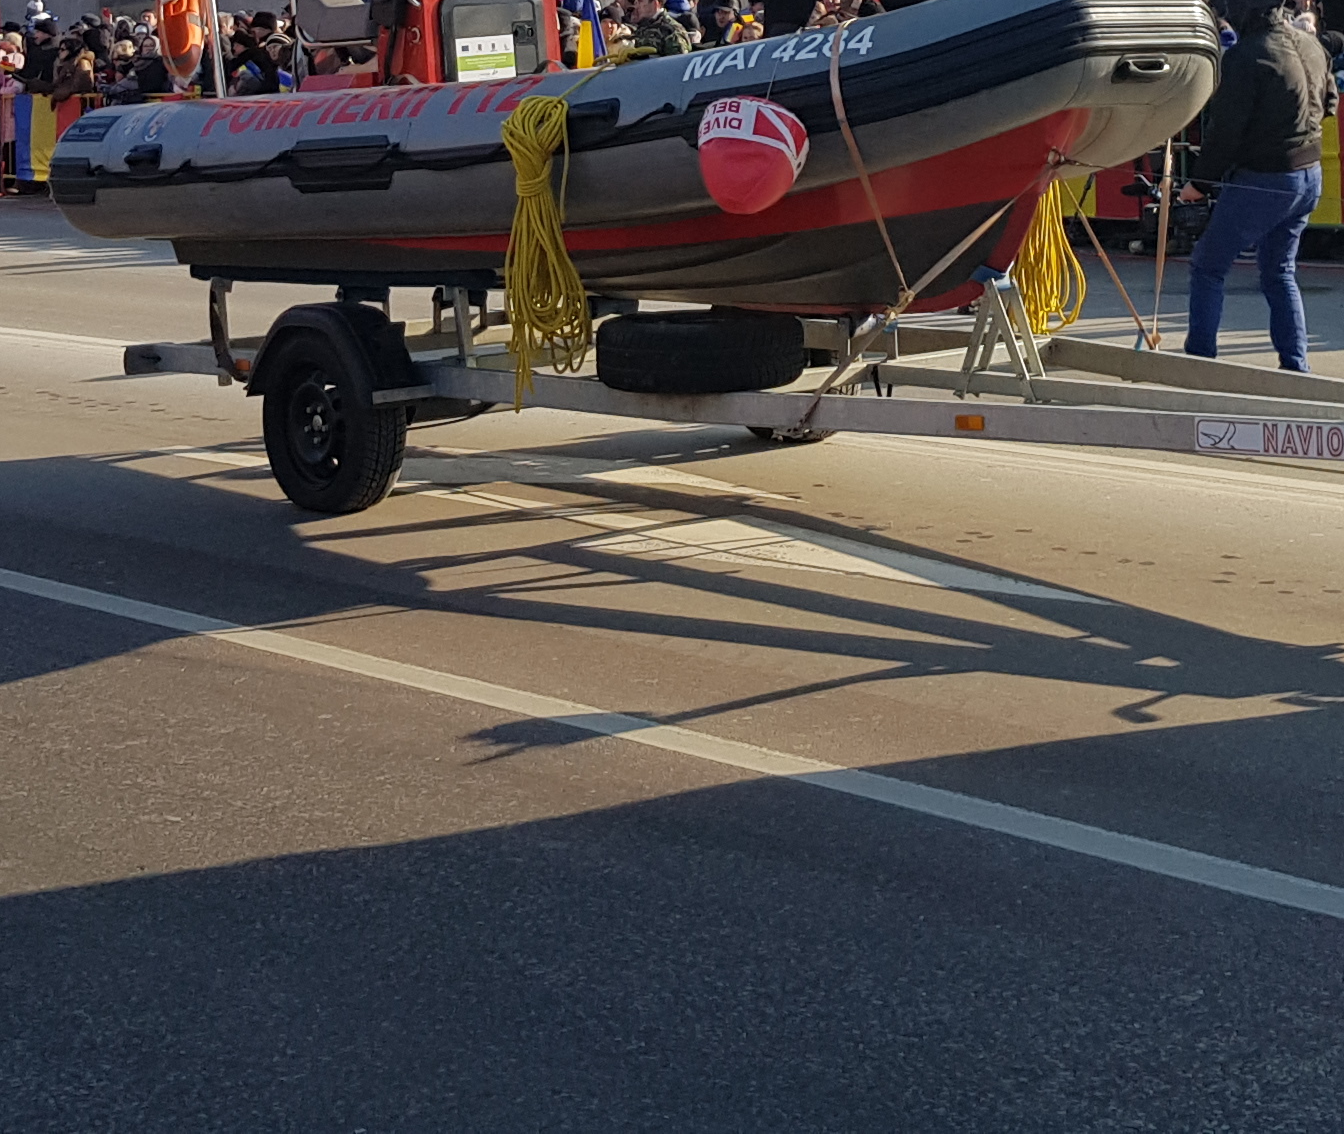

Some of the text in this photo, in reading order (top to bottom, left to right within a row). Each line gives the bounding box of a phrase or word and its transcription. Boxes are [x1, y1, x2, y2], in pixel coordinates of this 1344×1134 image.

[682, 25, 875, 82] MAI 4284
[201, 75, 545, 137] POMPIERII 112
